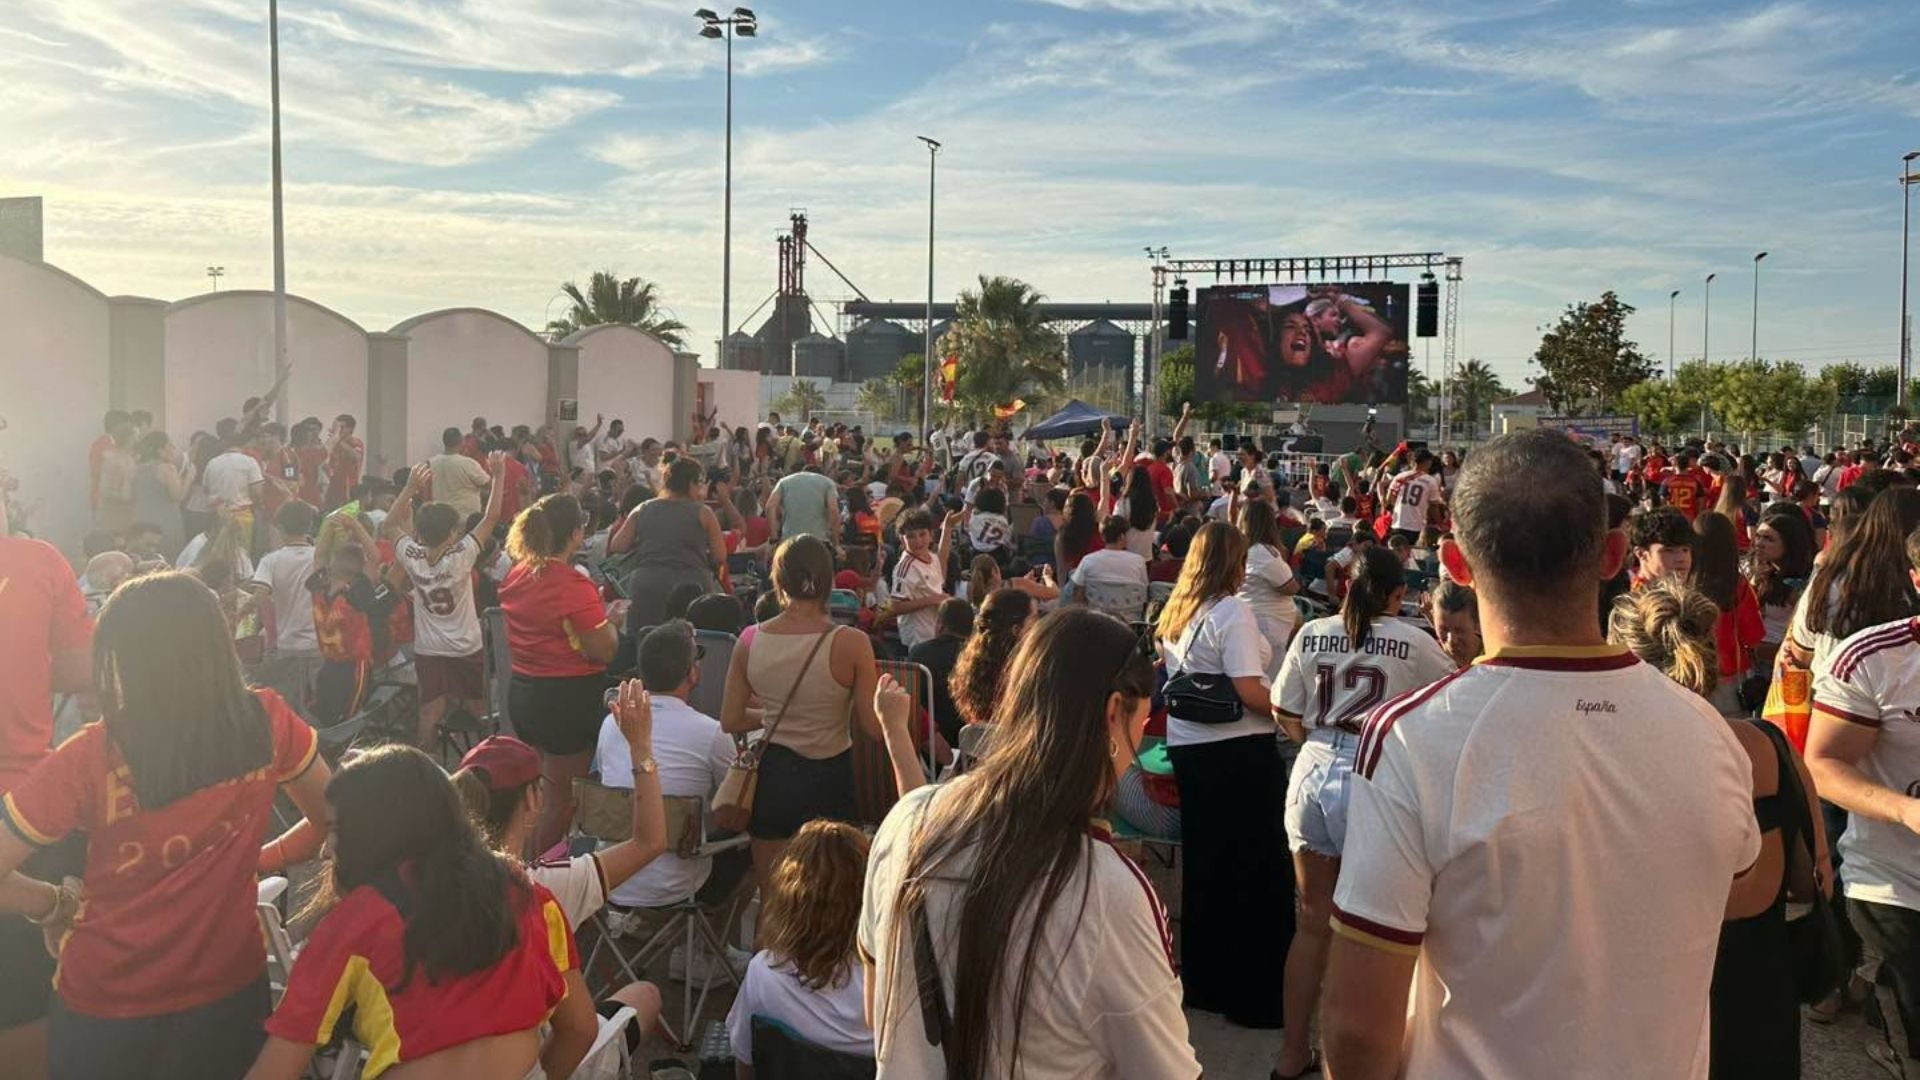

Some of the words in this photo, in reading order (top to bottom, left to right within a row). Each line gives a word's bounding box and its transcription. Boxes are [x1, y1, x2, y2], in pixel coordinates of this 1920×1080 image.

[1401, 482, 1424, 506] 19
[1671, 487, 1692, 508] 12
[1302, 635, 1350, 654] PEDRO
[1353, 636, 1409, 660] ORRO
[1315, 663, 1389, 728] 12
